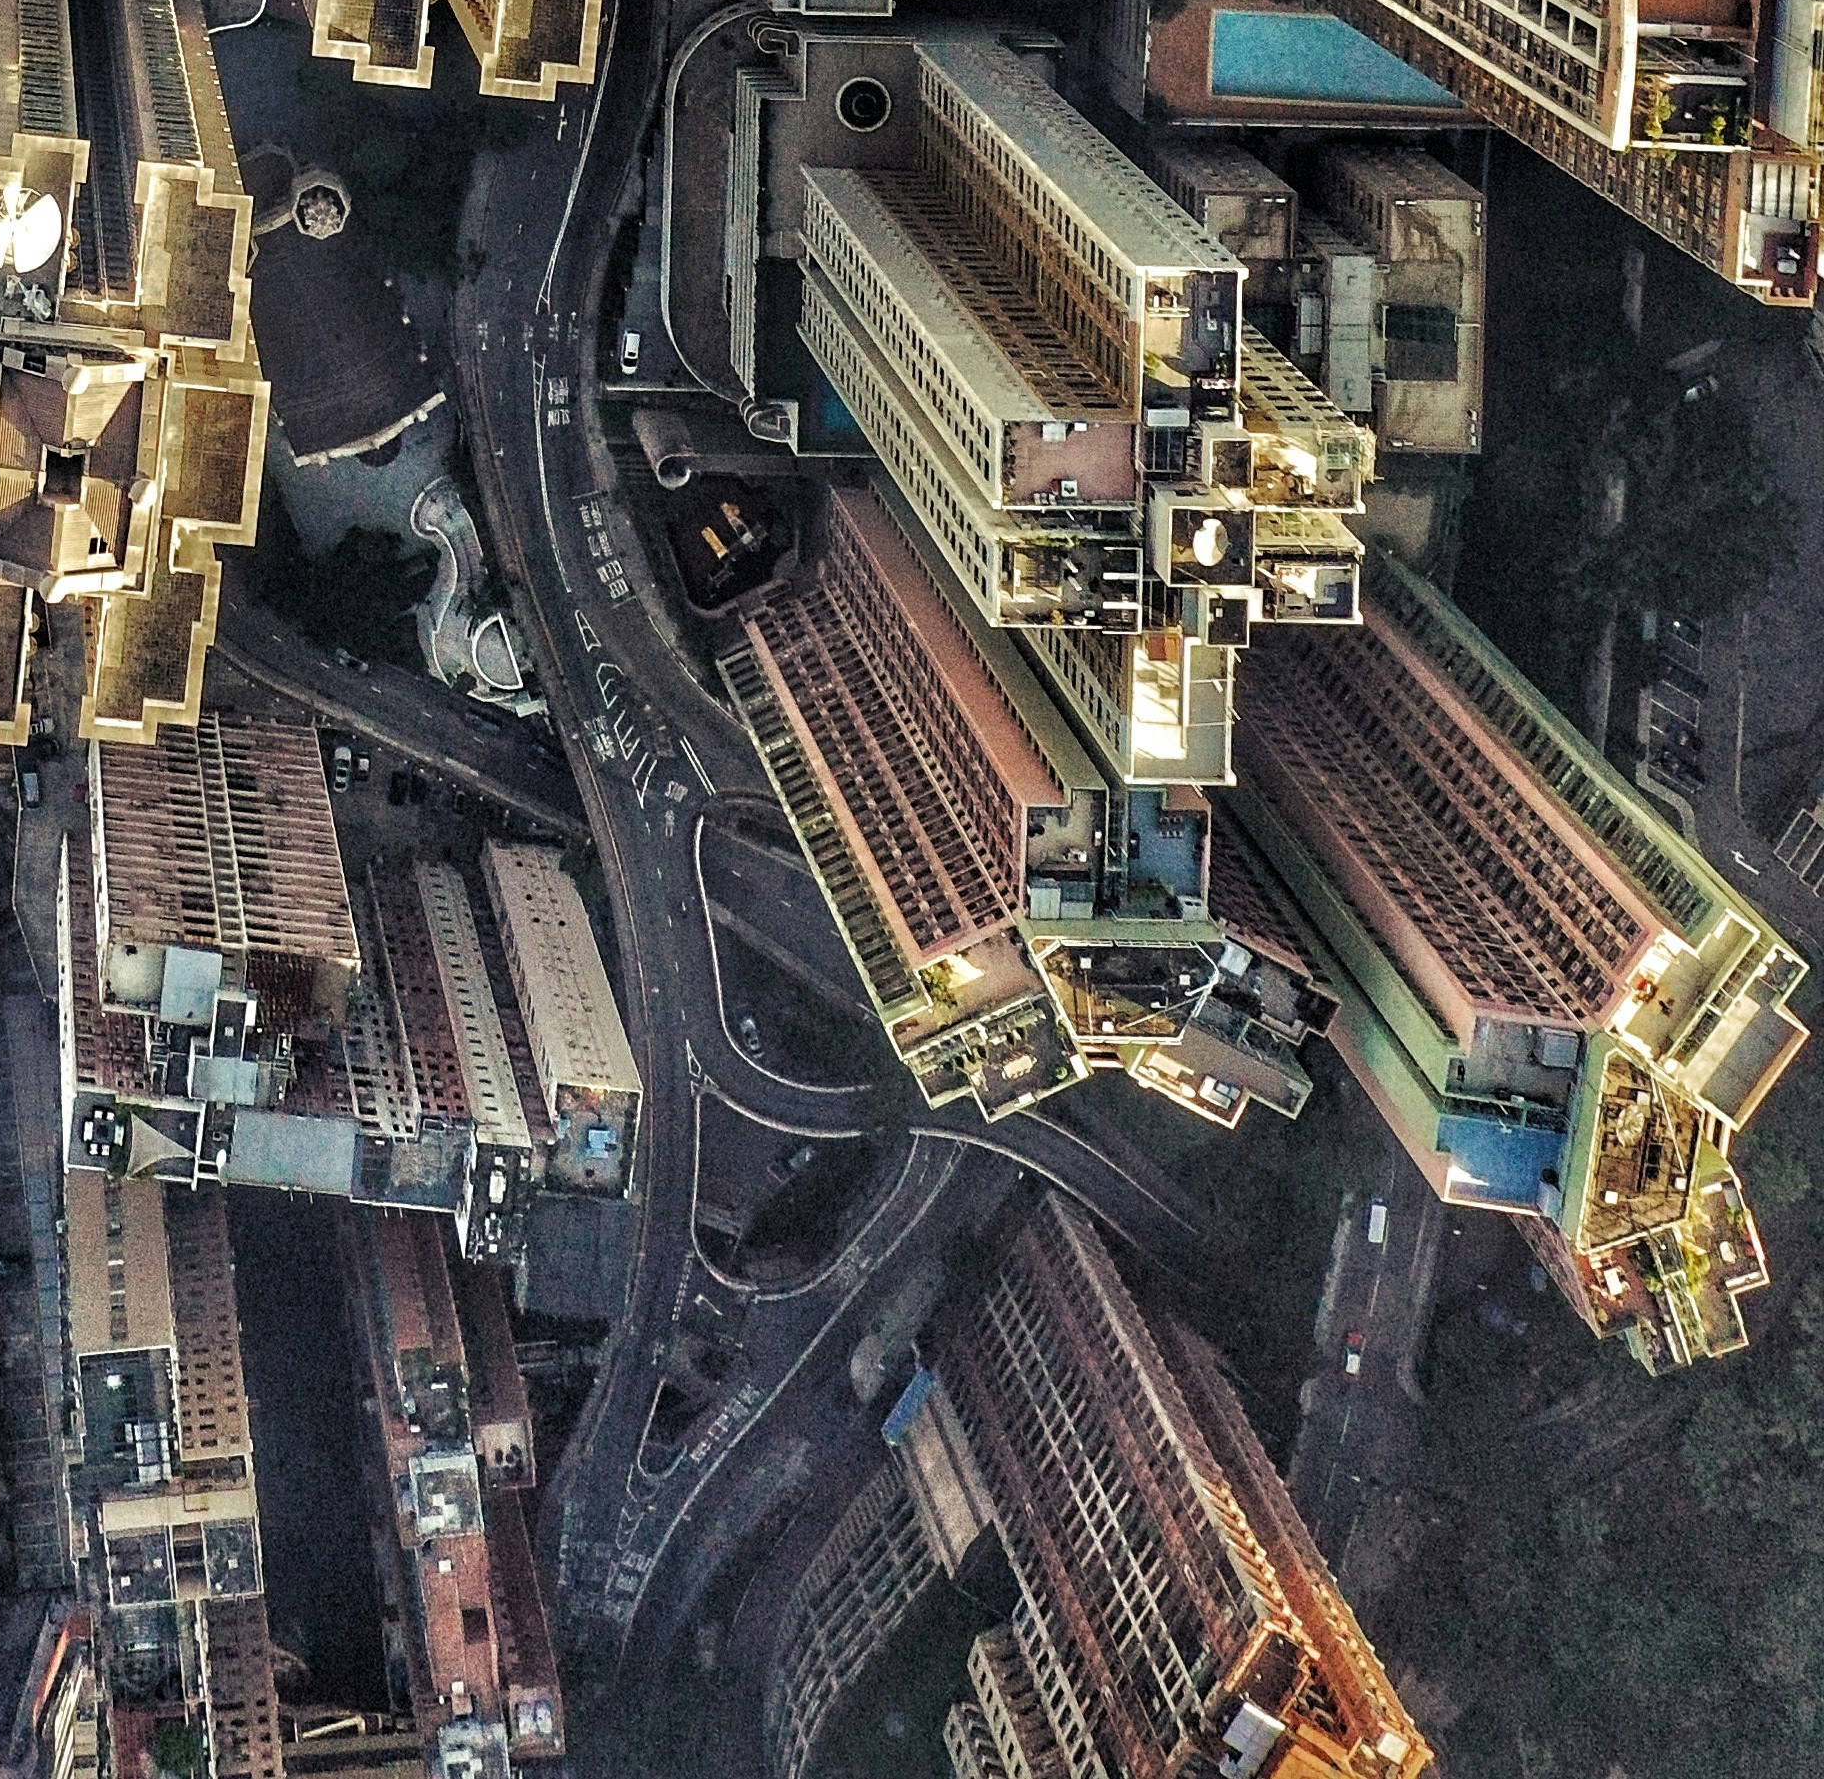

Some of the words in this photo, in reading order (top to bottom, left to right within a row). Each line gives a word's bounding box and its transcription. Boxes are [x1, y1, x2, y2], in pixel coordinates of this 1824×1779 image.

[547, 409, 570, 427] SLOW
[596, 559, 624, 583] CLEAR
[608, 578, 630, 599] KEEP
